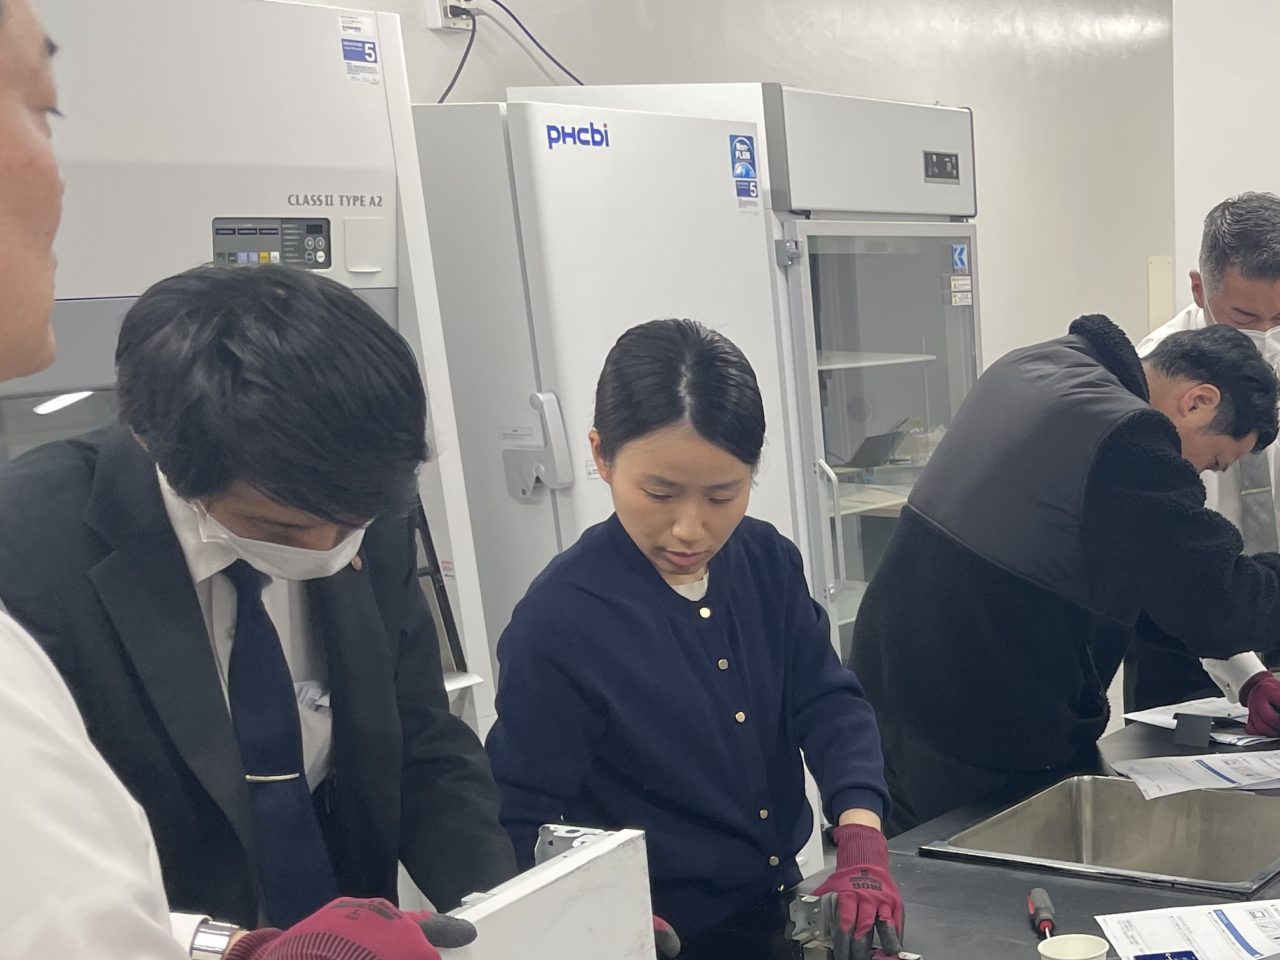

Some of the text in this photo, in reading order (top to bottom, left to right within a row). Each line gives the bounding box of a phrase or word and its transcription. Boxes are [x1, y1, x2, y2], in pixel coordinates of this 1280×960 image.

[364, 43, 376, 62] 5
[749, 182, 758, 197] 5
[287, 193, 323, 207] CLASS
[338, 194, 366, 208] TYPE
[368, 195, 383, 208] A2
